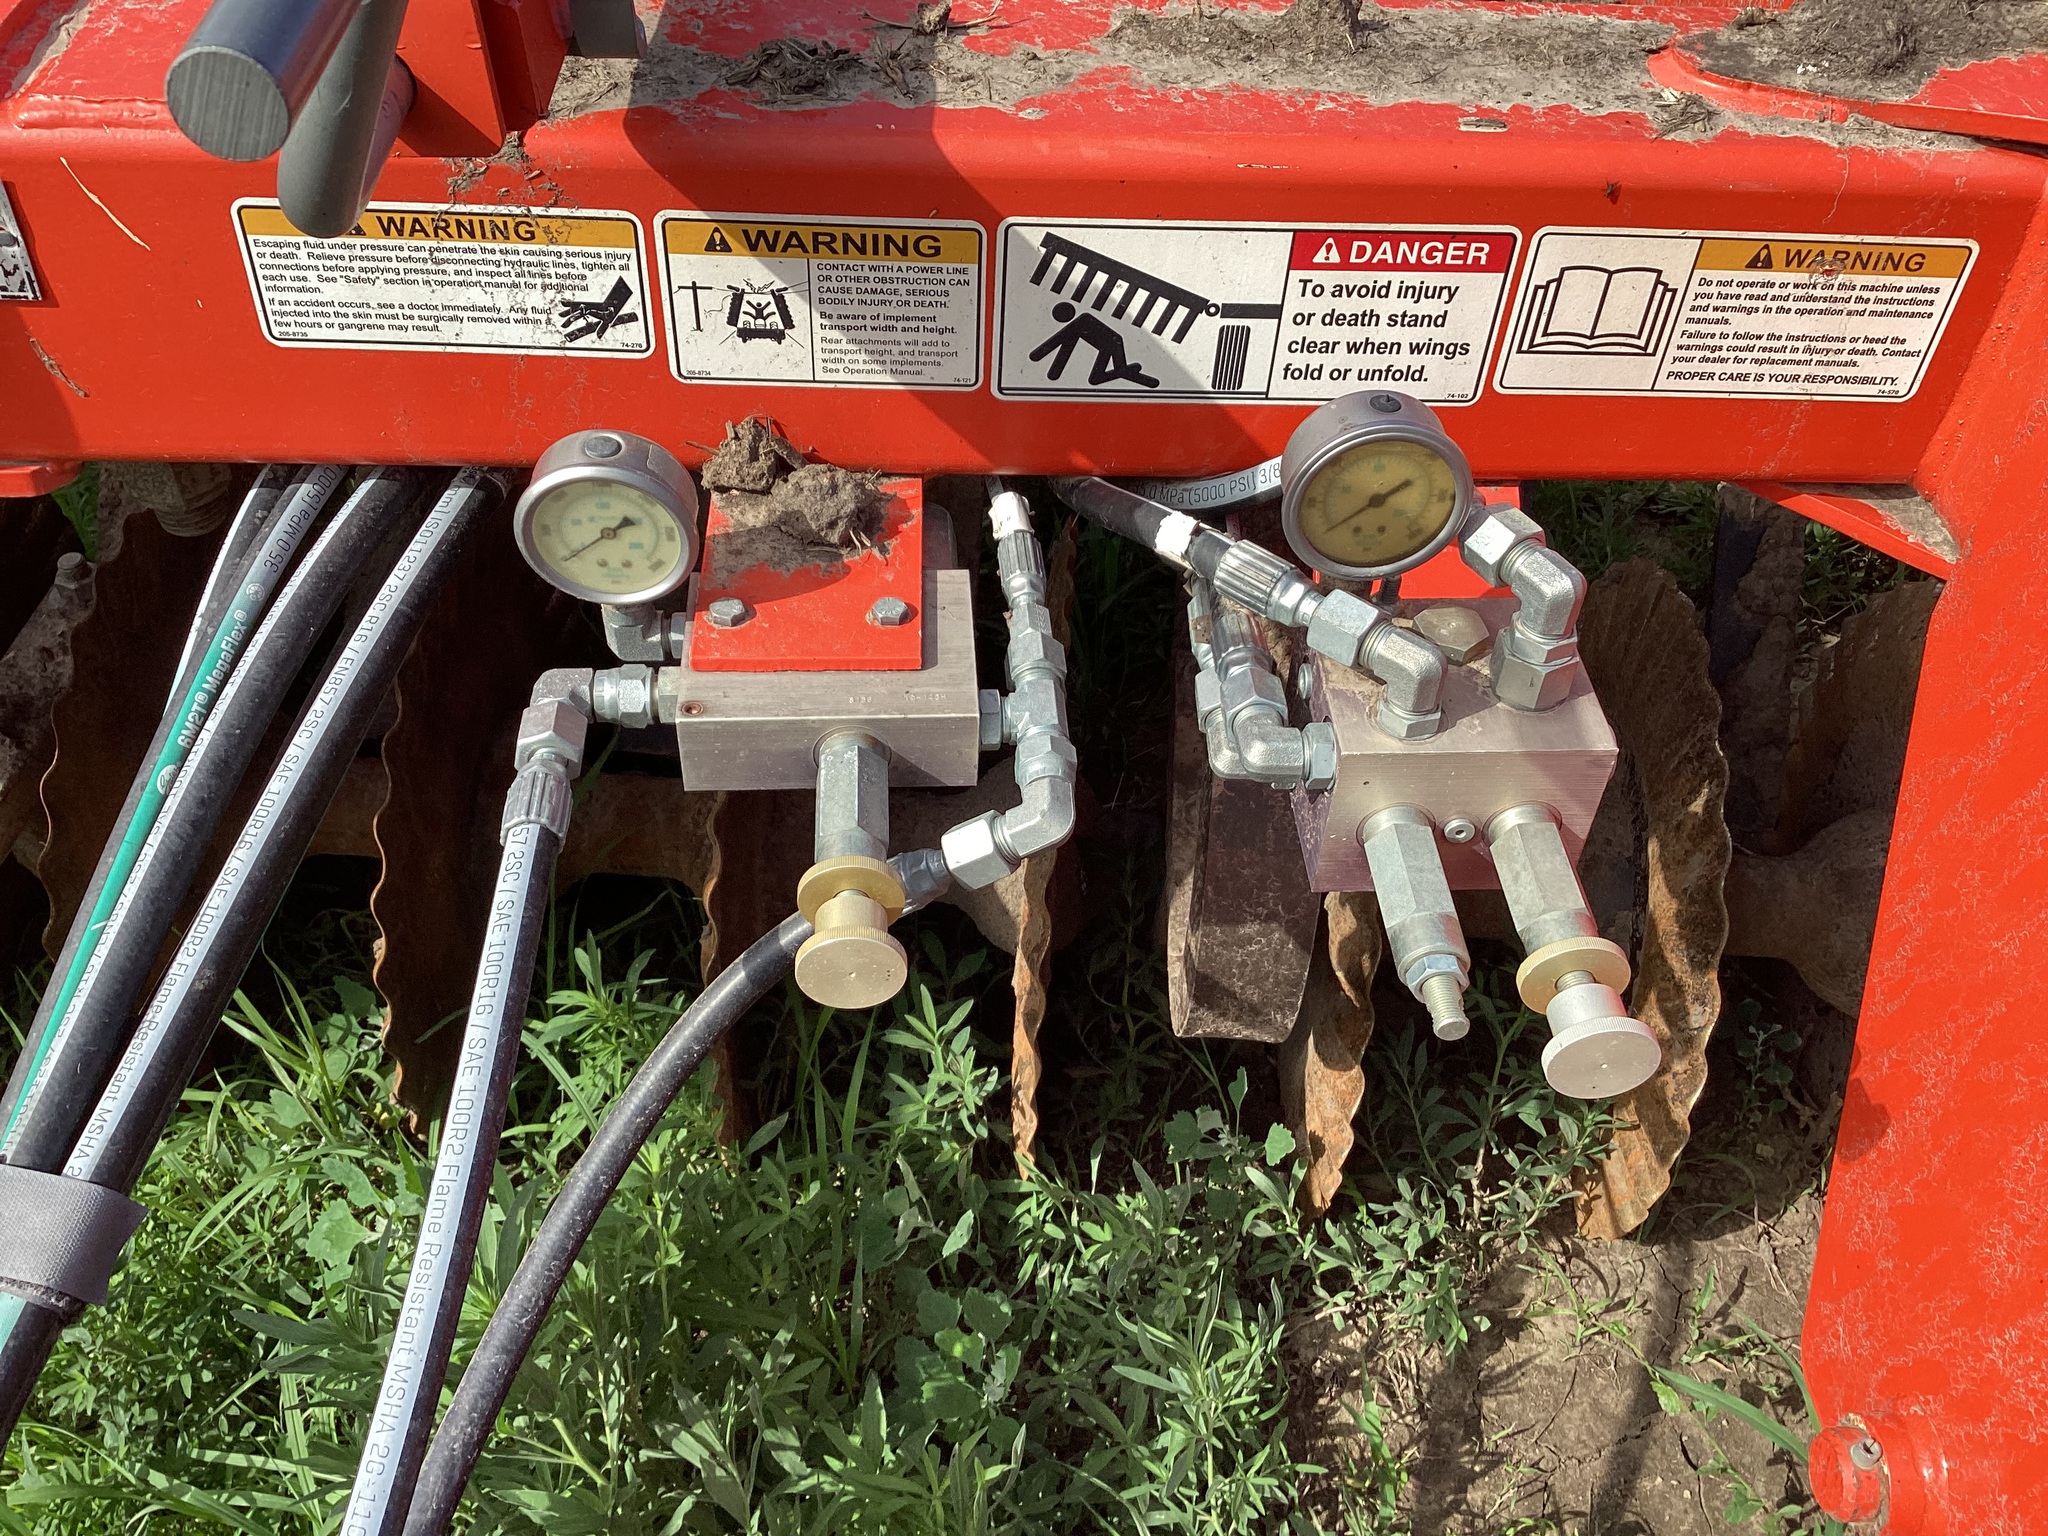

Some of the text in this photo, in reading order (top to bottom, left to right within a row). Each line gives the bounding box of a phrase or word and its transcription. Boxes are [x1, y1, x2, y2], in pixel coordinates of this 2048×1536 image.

[376, 216, 536, 241] WARNING
[253, 238, 300, 250] Escaping
[302, 240, 325, 249] fluid
[327, 241, 356, 250] under
[359, 244, 404, 252] pressure
[427, 245, 477, 256] penetrate
[479, 245, 496, 254] the
[498, 246, 519, 256] skin
[522, 248, 563, 259] causing
[564, 250, 601, 258] serious
[604, 250, 631, 262] injury
[742, 229, 942, 257] WARNING
[1350, 241, 1490, 265] DANGER
[816, 262, 864, 271] CONTACT
[867, 264, 893, 272] WITH
[905, 265, 943, 274] POWER
[1785, 248, 1926, 272] WARNING
[264, 284, 322, 293] information.
[817, 274, 832, 282] OR
[835, 274, 870, 283] OTHER
[872, 276, 945, 285] OBSTRUCTION
[817, 285, 949, 297] CAUSE DAMAGE, SERIOUS
[1300, 278, 1458, 303] To avoid injury
[1697, 277, 1713, 286] Do
[1715, 278, 1734, 287] not
[1735, 280, 1775, 289] operate
[1792, 280, 1820, 290] work
[1836, 281, 1856, 291] this
[1858, 283, 1903, 292] machine
[1905, 284, 1940, 293] unless
[268, 297, 274, 305] If
[293, 299, 335, 307] accident
[337, 301, 374, 309] occurs,
[407, 302, 439, 310] doctor
[441, 303, 502, 314] immediately.
[508, 304, 528, 315] Any
[530, 305, 552, 315] fluid
[818, 297, 854, 305] BODILY
[270, 308, 309, 318] injected
[312, 310, 330, 318] into
[332, 310, 349, 318] the
[351, 311, 372, 319] skin
[401, 312, 414, 320] be
[417, 314, 463, 323] surgically
[512, 316, 542, 324] within
[273, 318, 291, 327] few
[293, 319, 322, 328] hours
[337, 322, 384, 331] gangrene
[387, 324, 408, 332] may
[819, 310, 833, 319] Be
[869, 312, 880, 320] of
[883, 313, 936, 322] implement
[819, 322, 867, 332] transport
[922, 325, 957, 335] height.
[1292, 308, 1447, 327] or death stand
[1684, 316, 1731, 324] manuals.
[1287, 336, 1469, 359] clear when wings
[1680, 329, 1716, 339] Failure
[1718, 331, 1729, 339] to
[1732, 331, 1764, 340] follow
[1765, 332, 1782, 341] the
[1784, 333, 1846, 342] instructions
[1862, 335, 1888, 344] heed
[1889, 336, 1906, 344] the
[1676, 343, 1723, 353] warnings
[1726, 343, 1756, 352] could
[1756, 344, 1787, 353] result
[1788, 344, 1799, 353] in
[1802, 346, 1832, 356] injury
[1847, 346, 1877, 356] death.
[1881, 347, 1921, 357] Contact
[1283, 363, 1427, 381] fold or unfold.
[1666, 370, 1898, 385] PROPER CARE IS YOUR RESPONSIBILITY.
[1160, 487, 1184, 503] MPa
[264, 538, 290, 572] 35.0
[283, 510, 310, 540] MPa
[373, 585, 398, 611] 2SC
[354, 616, 379, 642] R16
[320, 657, 354, 705] EN857
[299, 710, 324, 739] 2SC
[275, 754, 299, 784] SAE
[239, 790, 280, 850] 100R16
[503, 851, 524, 882] 2SC
[214, 867, 238, 898] SAE
[492, 900, 514, 934] SAE
[182, 904, 219, 957] 100R2
[150, 962, 188, 1014] Flame
[476, 941, 506, 1015] 100R16
[104, 1018, 158, 1102] Resistant
[462, 1038, 486, 1076] SAE
[445, 1085, 477, 1155] 100R2
[74, 1108, 112, 1159] MSHA
[428, 1164, 460, 1234] Flame
[397, 1242, 442, 1356] Resistant
[376, 1364, 412, 1434] MSHA
